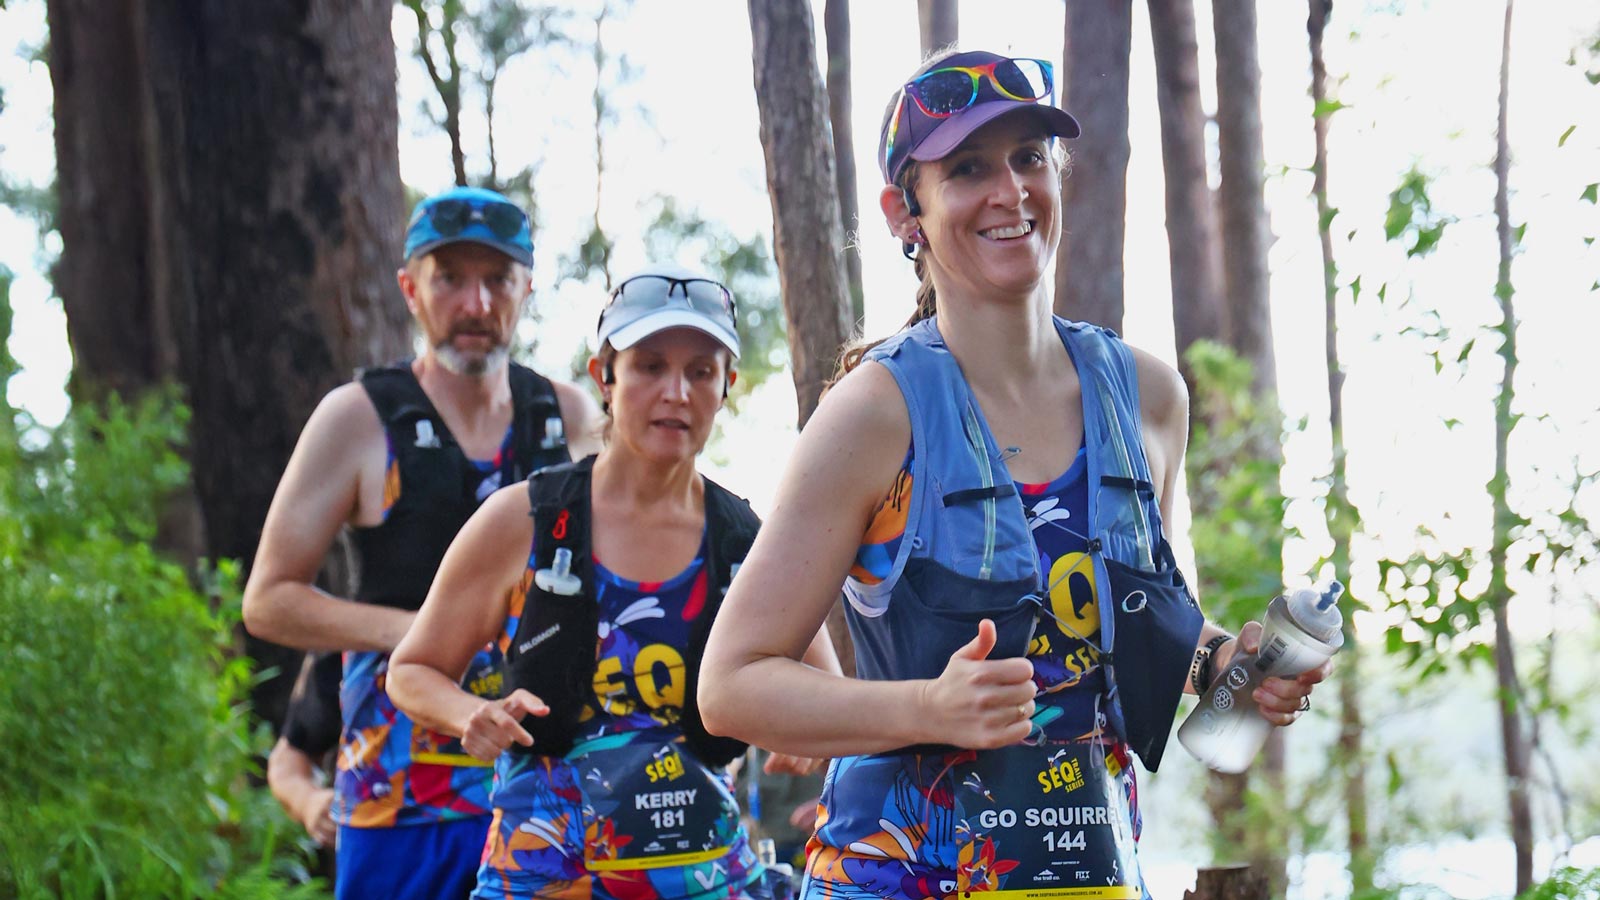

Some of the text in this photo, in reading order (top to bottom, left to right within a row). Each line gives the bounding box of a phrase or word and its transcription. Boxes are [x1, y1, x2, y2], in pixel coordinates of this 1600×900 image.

[645, 755, 677, 783] SEQ
[1037, 761, 1075, 794] SEQ
[1064, 778, 1085, 793] SERIES
[635, 789, 697, 810] KERRY
[650, 809, 685, 829] 181
[979, 809, 1017, 829] GO
[1042, 830, 1087, 852] 144
